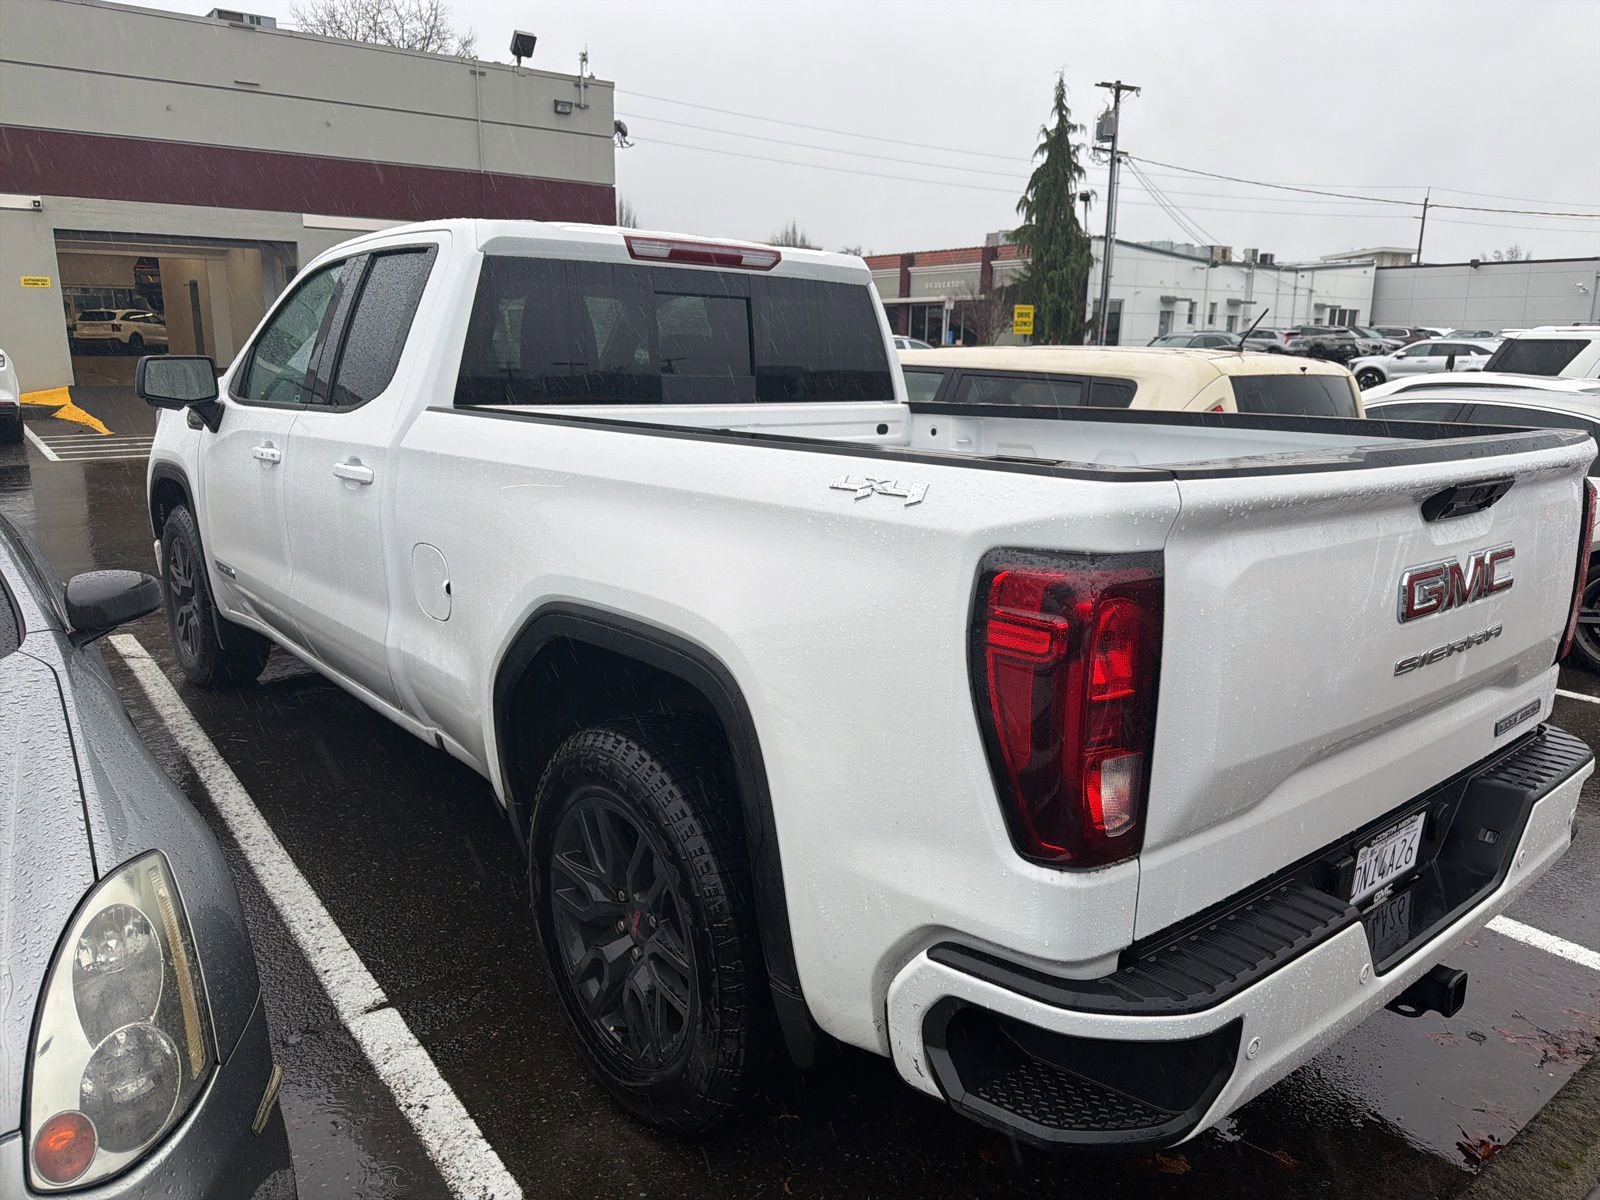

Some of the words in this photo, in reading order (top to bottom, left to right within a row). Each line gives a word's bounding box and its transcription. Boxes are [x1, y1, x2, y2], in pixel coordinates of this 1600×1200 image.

[1397, 541, 1516, 624] GMC
[1394, 623, 1503, 676] SIERRA
[1373, 882, 1394, 902] GMC
